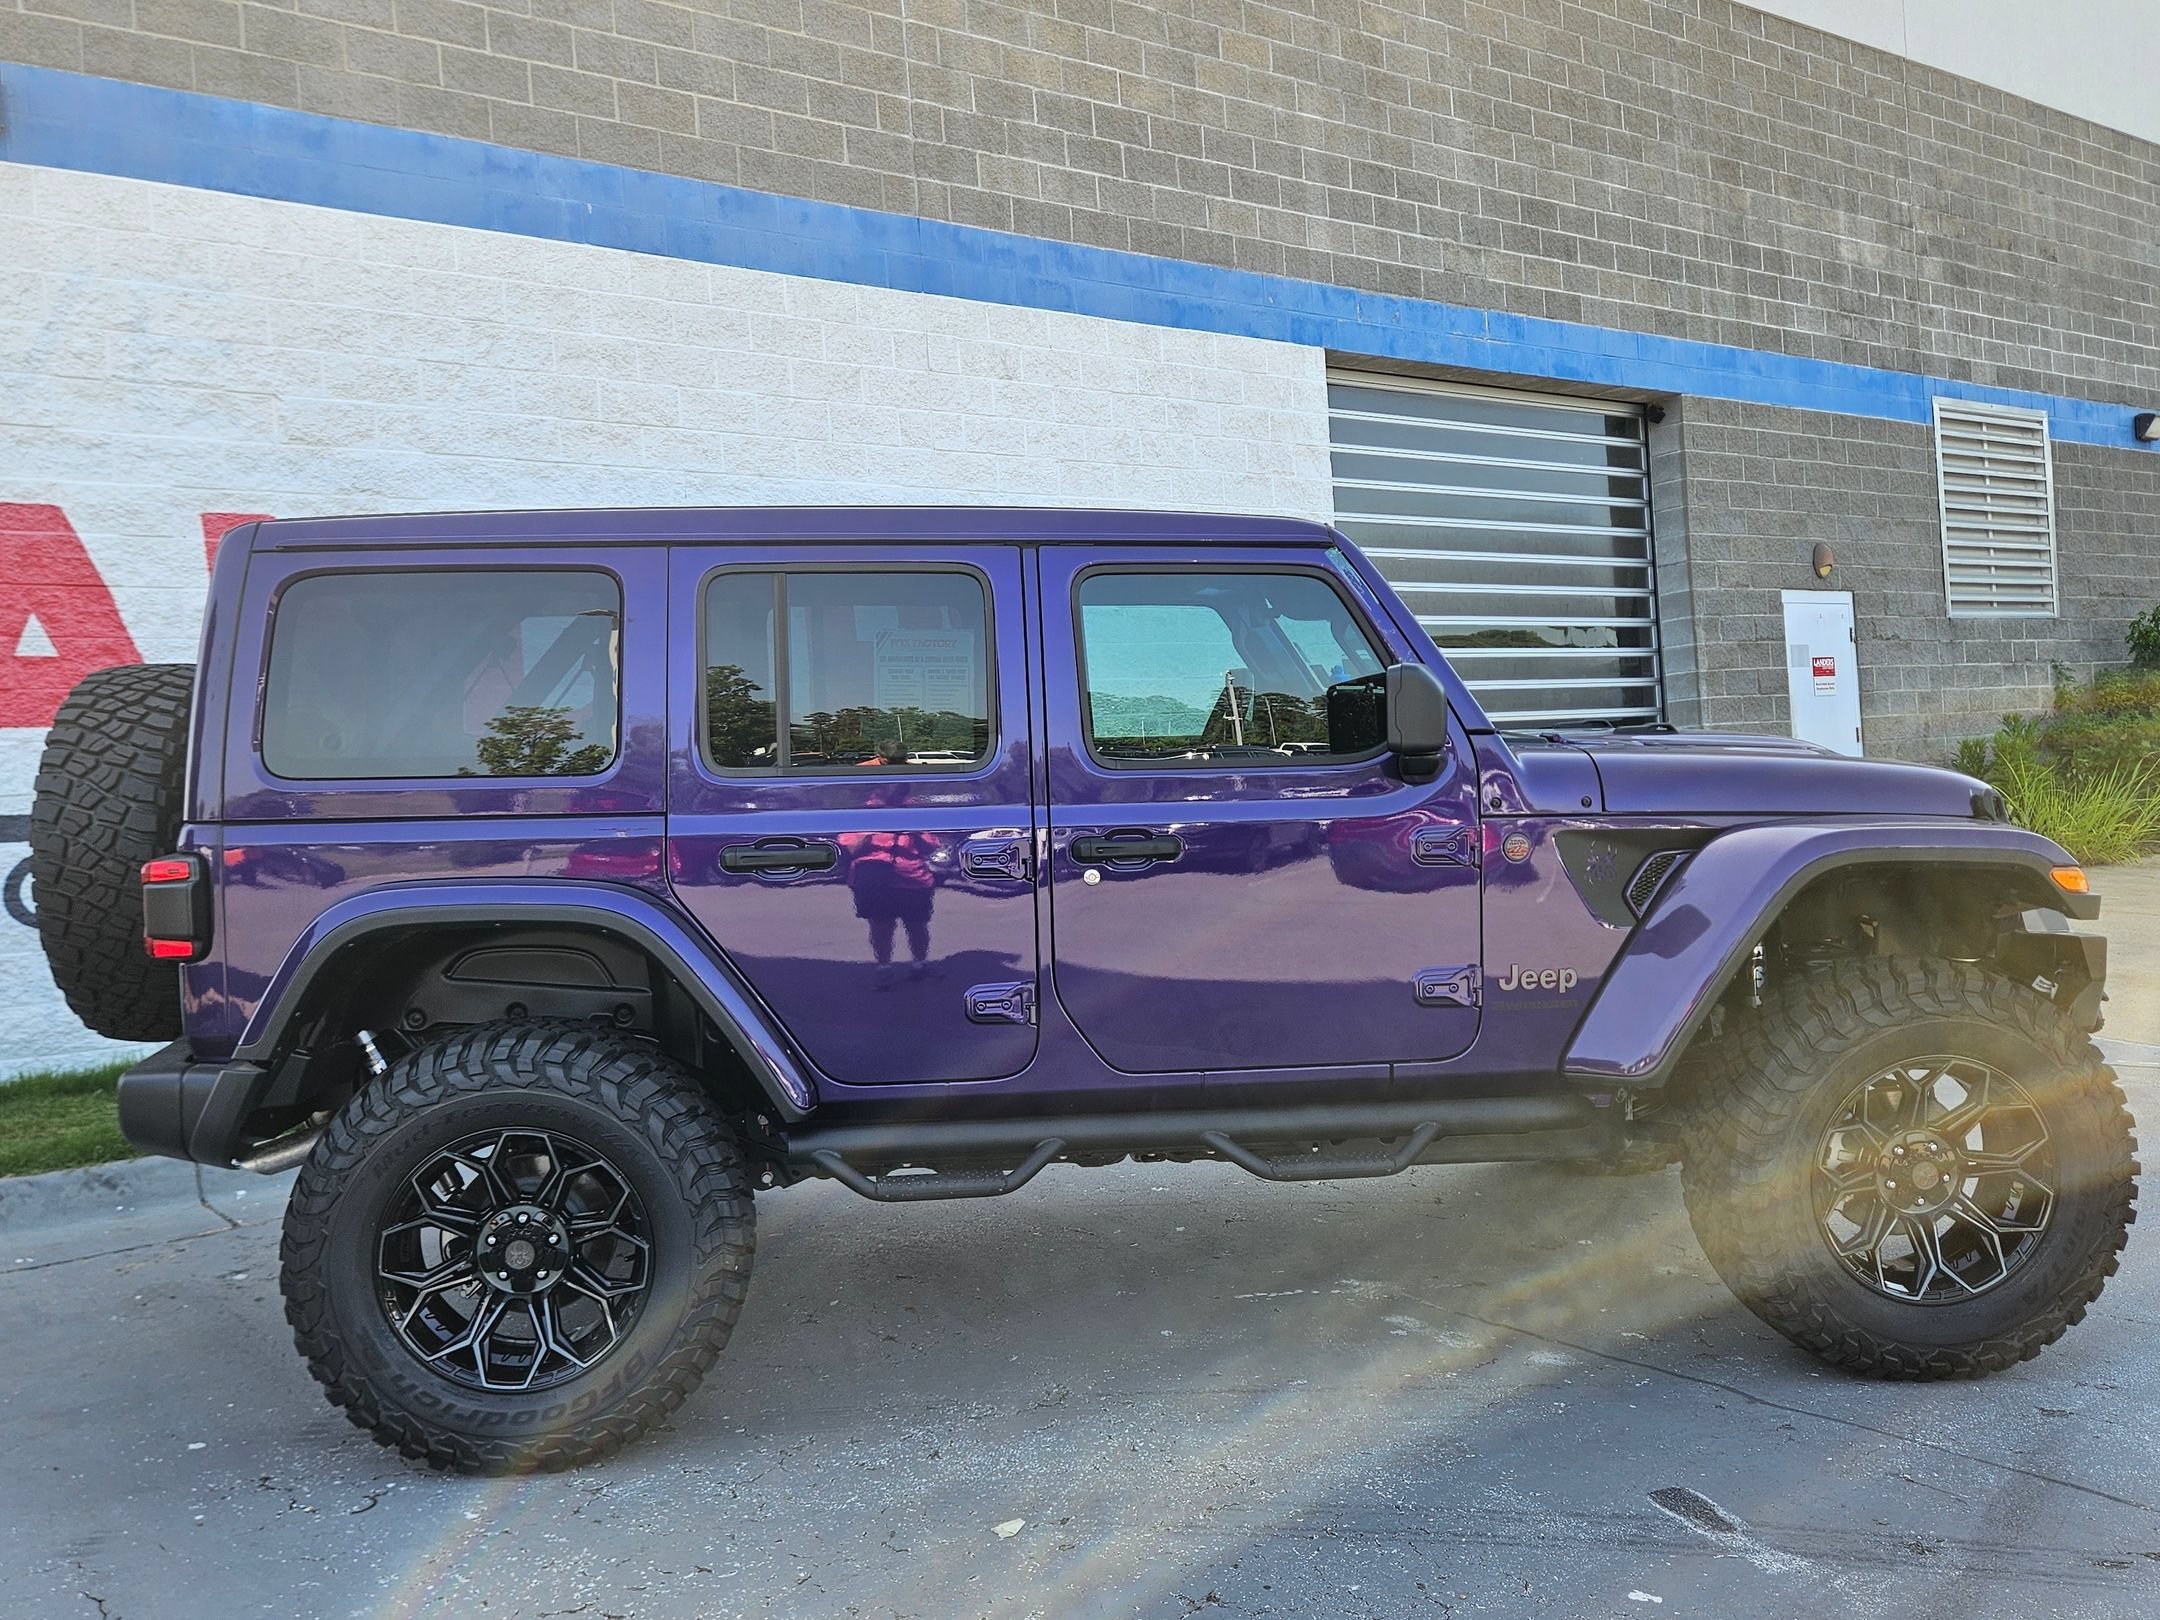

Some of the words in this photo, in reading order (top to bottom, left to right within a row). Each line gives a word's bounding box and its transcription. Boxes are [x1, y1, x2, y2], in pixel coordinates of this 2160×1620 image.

[1813, 658, 1834, 668] LANDERS
[1498, 964, 1577, 994] Jeep
[389, 1353, 646, 1428] BFGoodrich
